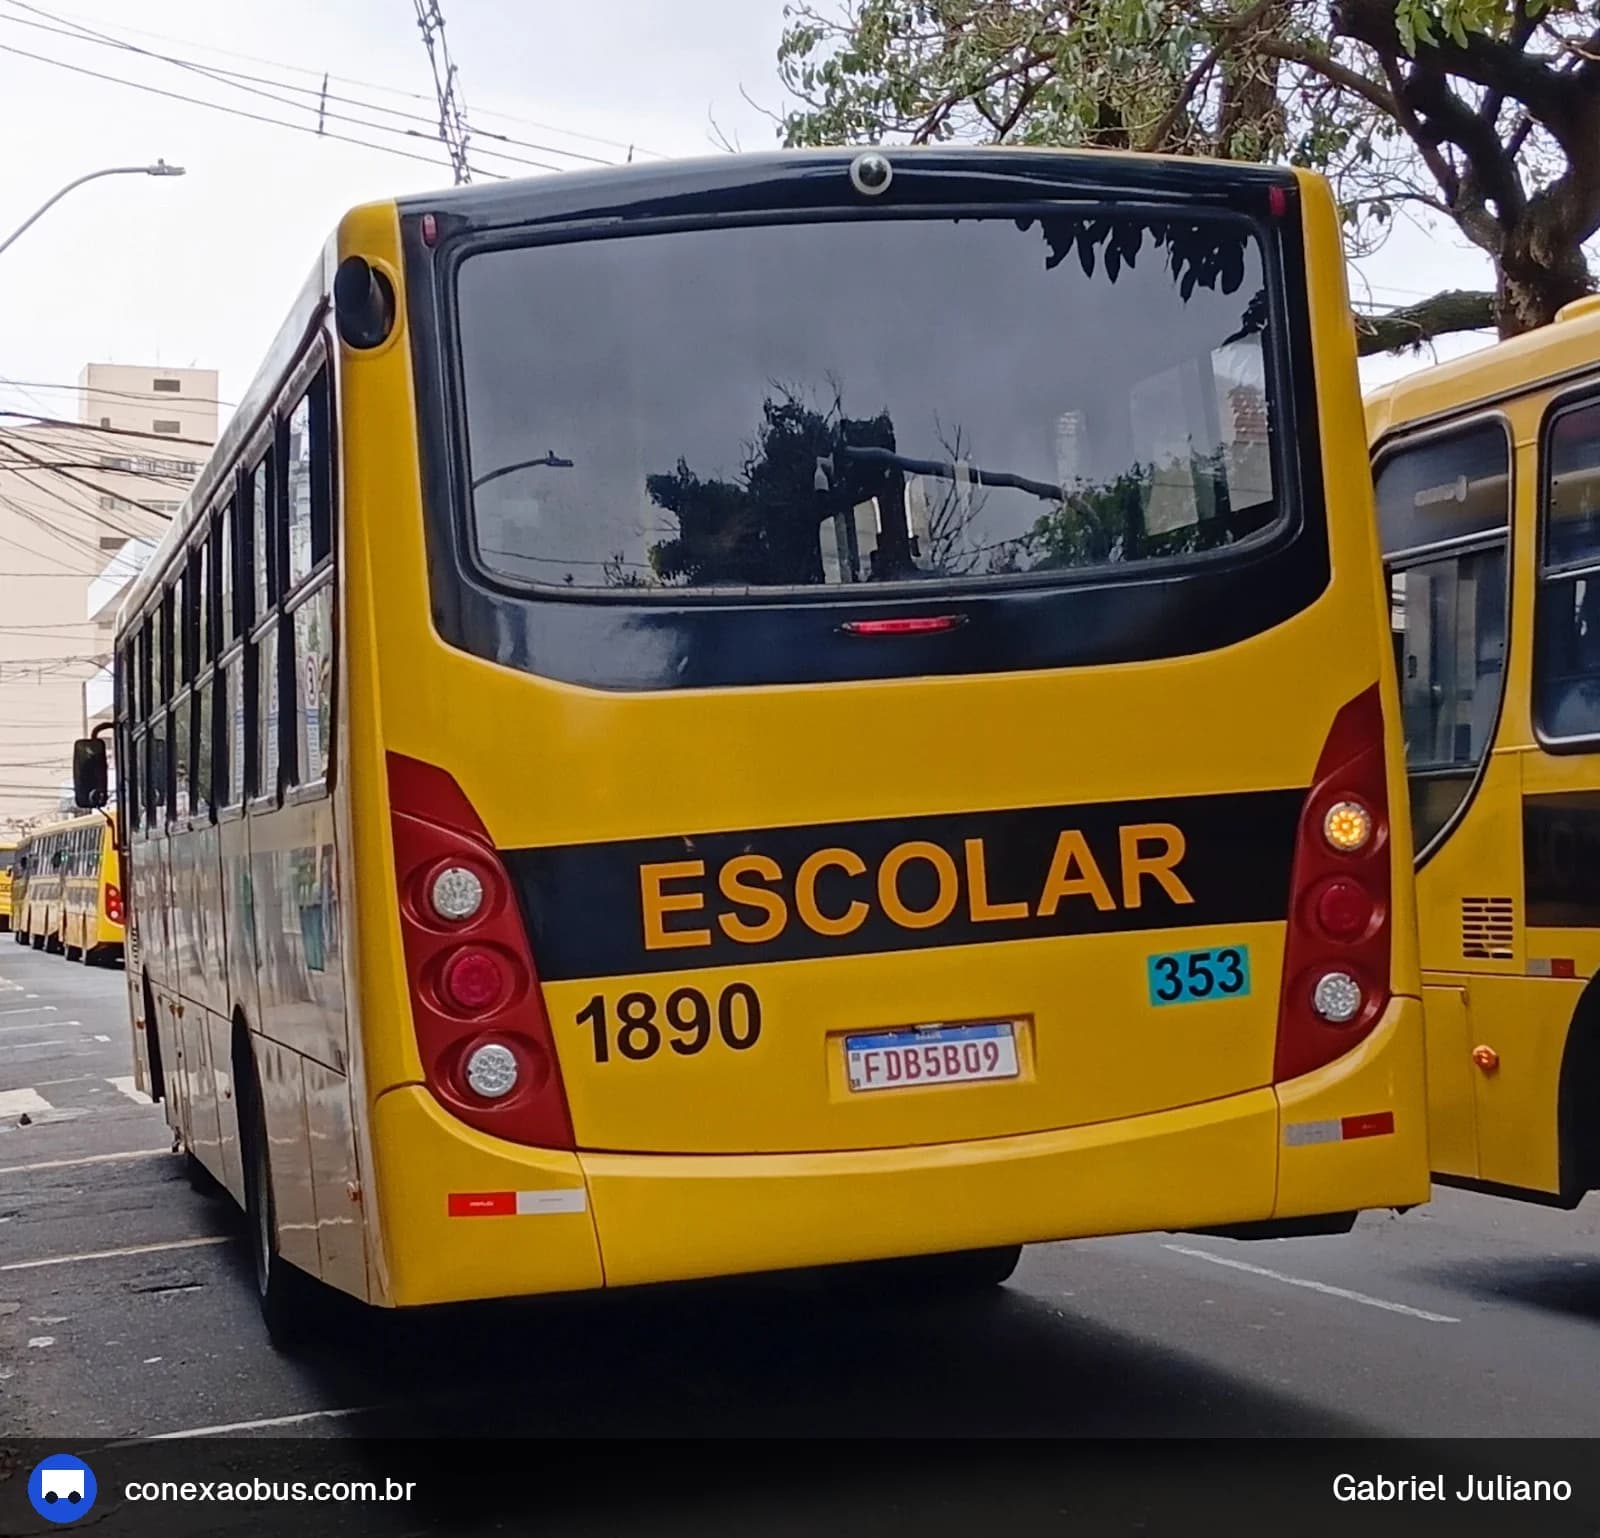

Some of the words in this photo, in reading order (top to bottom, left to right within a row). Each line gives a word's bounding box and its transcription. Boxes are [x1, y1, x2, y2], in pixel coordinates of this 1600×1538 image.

[640, 822, 1195, 950] ESCOLAR
[1155, 948, 1244, 1001] 353
[576, 982, 761, 1063] 1890
[864, 1042, 999, 1082] FDB5B09
